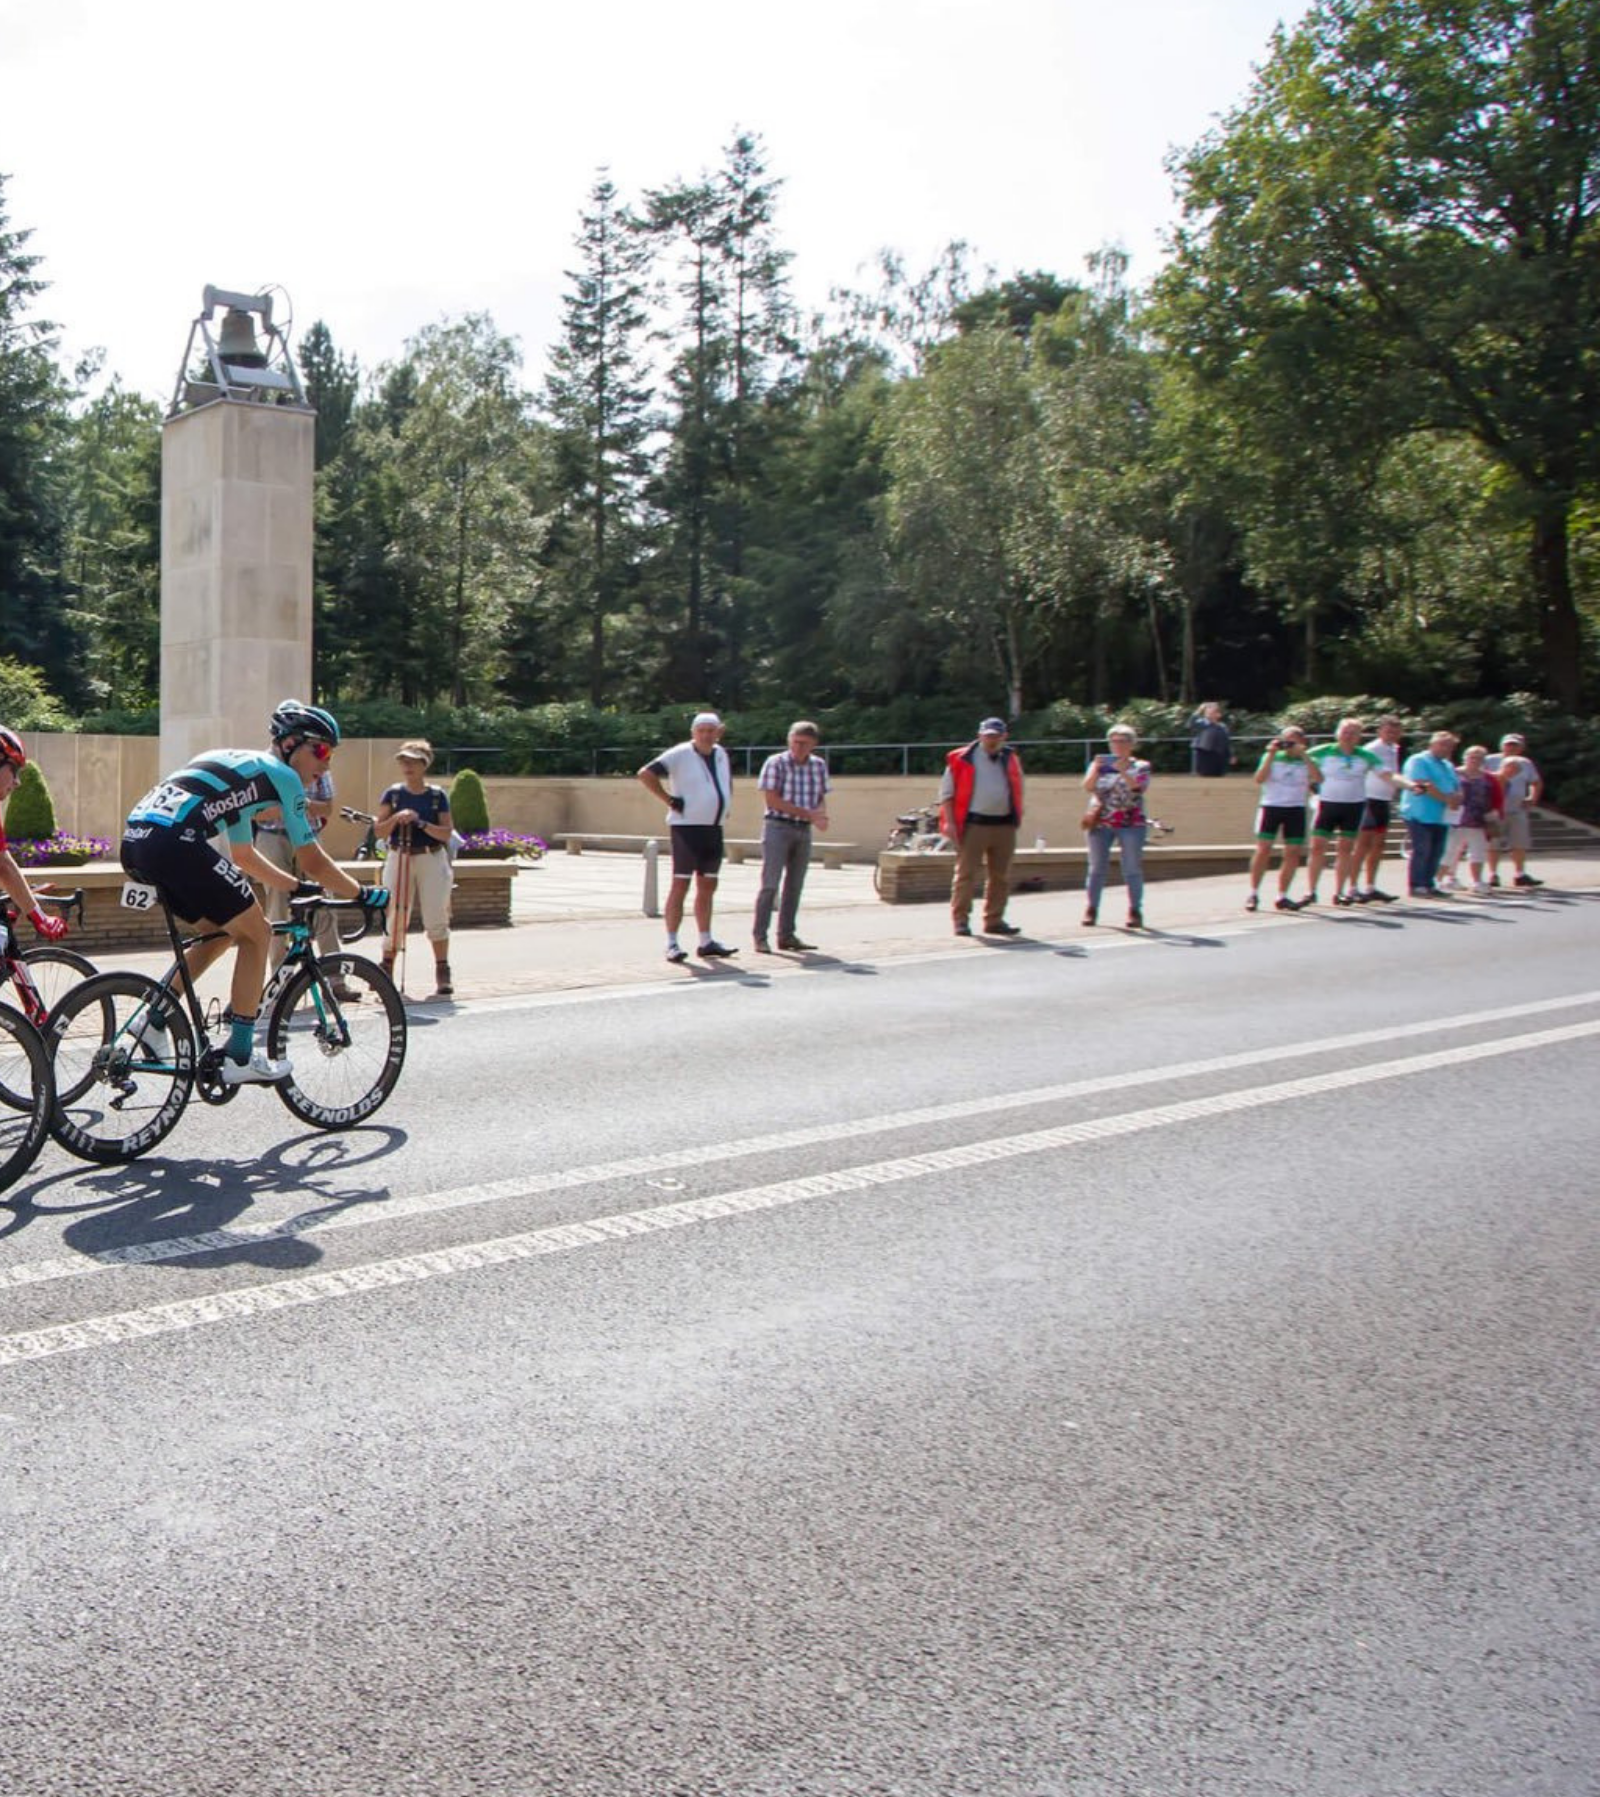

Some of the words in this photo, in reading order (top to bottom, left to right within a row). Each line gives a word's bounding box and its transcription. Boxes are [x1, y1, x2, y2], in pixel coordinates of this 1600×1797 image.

[213, 858, 253, 898] BEAT
[126, 888, 149, 908] 62
[121, 1038, 192, 1154] REYNOLDS
[286, 1086, 383, 1123] REYNOLDS
